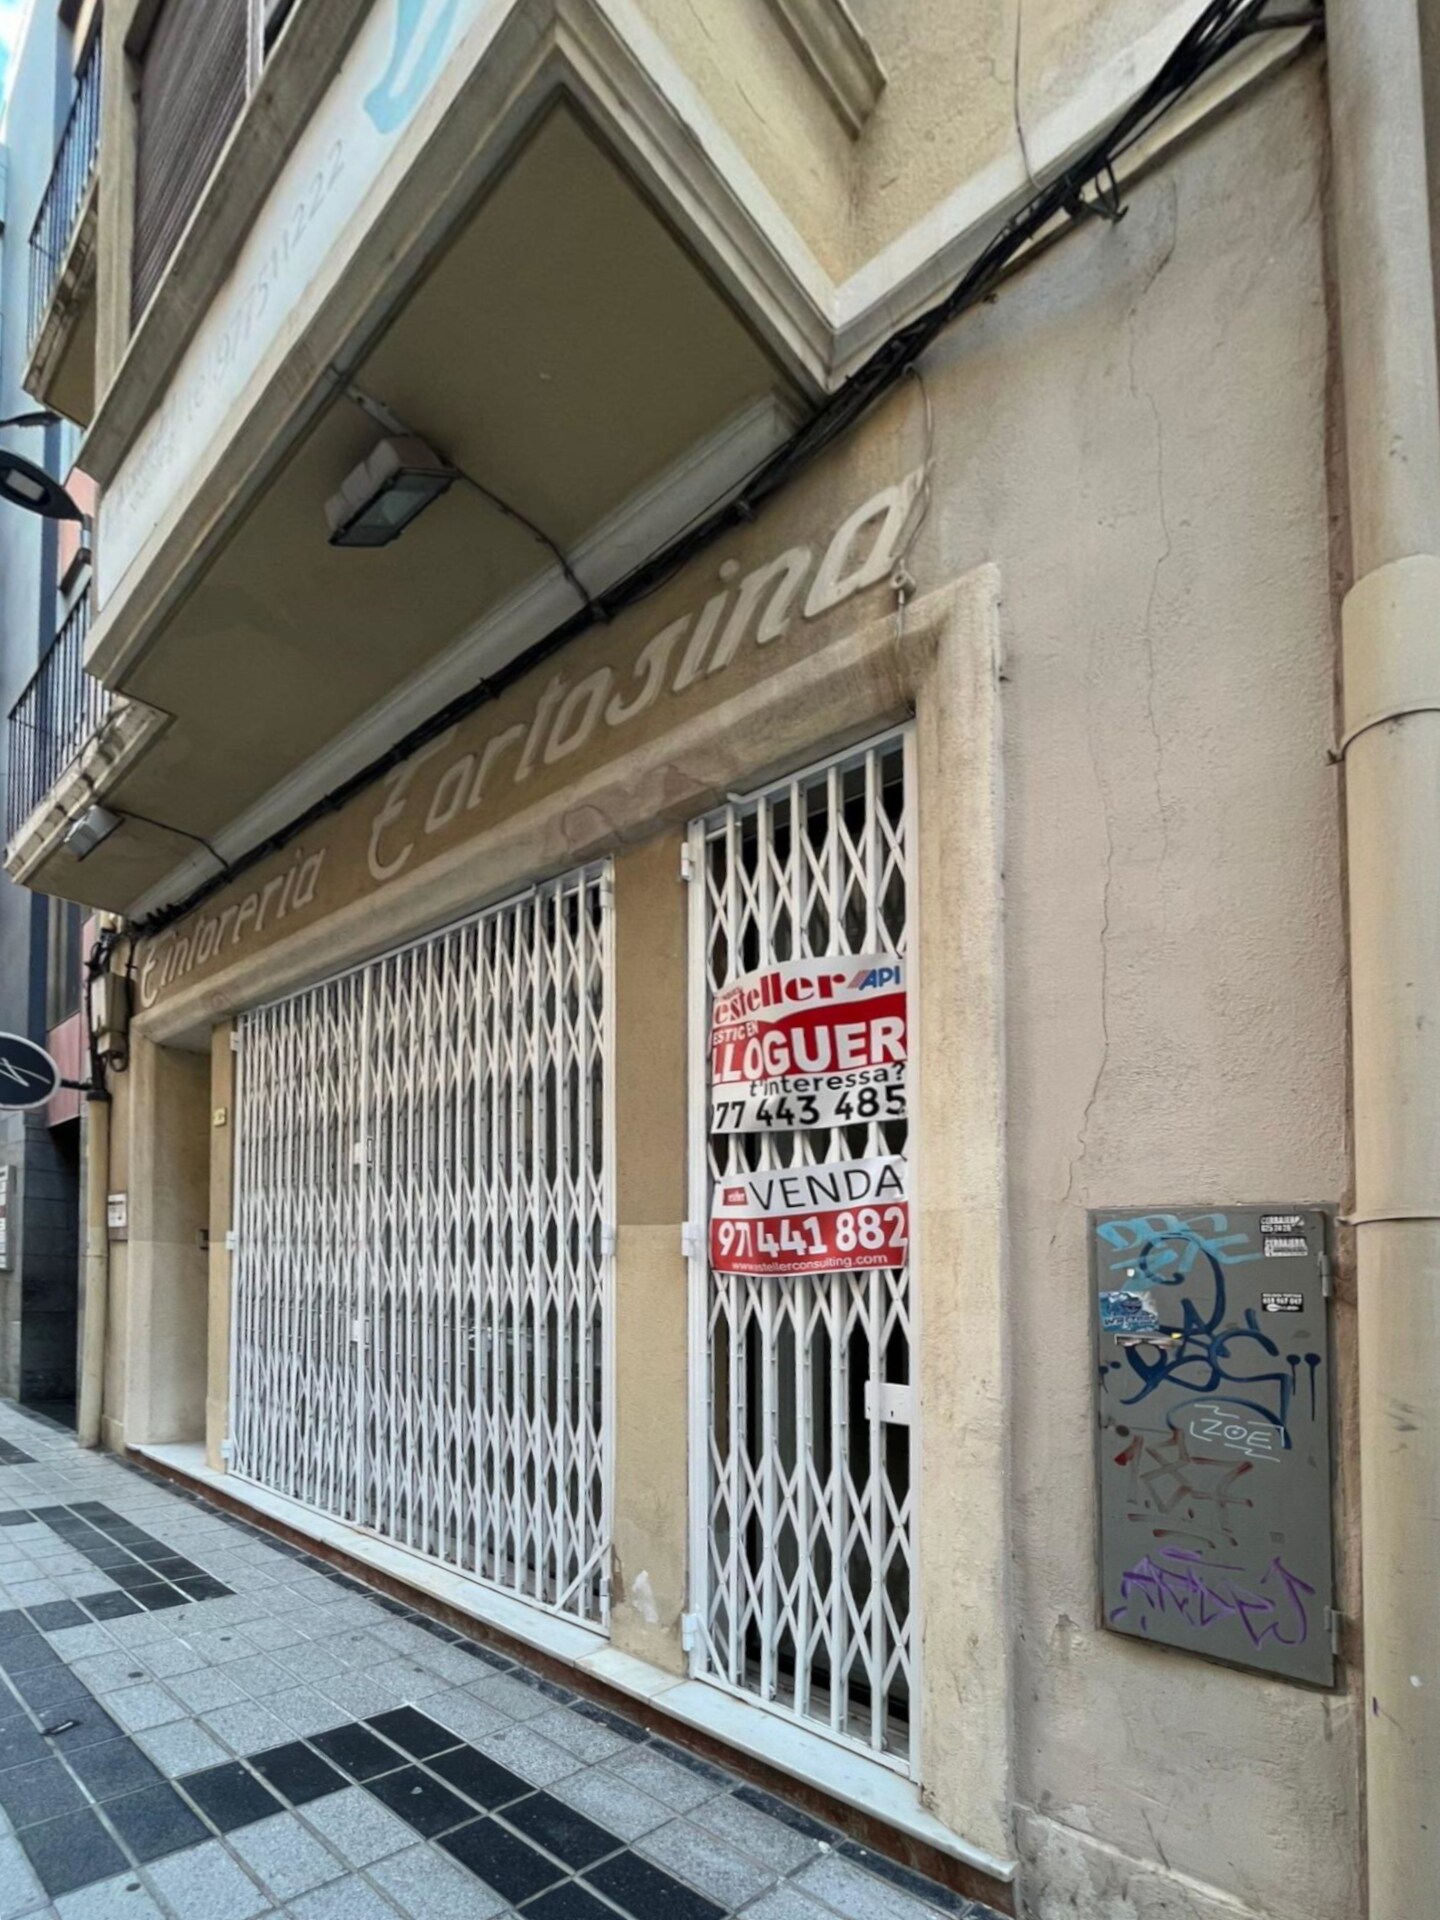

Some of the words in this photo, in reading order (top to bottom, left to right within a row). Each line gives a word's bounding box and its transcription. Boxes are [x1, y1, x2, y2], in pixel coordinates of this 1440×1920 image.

[859, 966, 901, 991] API
[712, 1016, 907, 1083] LLOGUER
[749, 1063, 906, 1097] t'interessa?
[712, 1101, 746, 1130] 77
[755, 1094, 820, 1128] 443
[834, 1084, 907, 1121] 485
[749, 1164, 904, 1211] VENDA
[757, 1216, 828, 1259] 441
[835, 1206, 908, 1252] 882
[1201, 1418, 1272, 1450] ZOE
